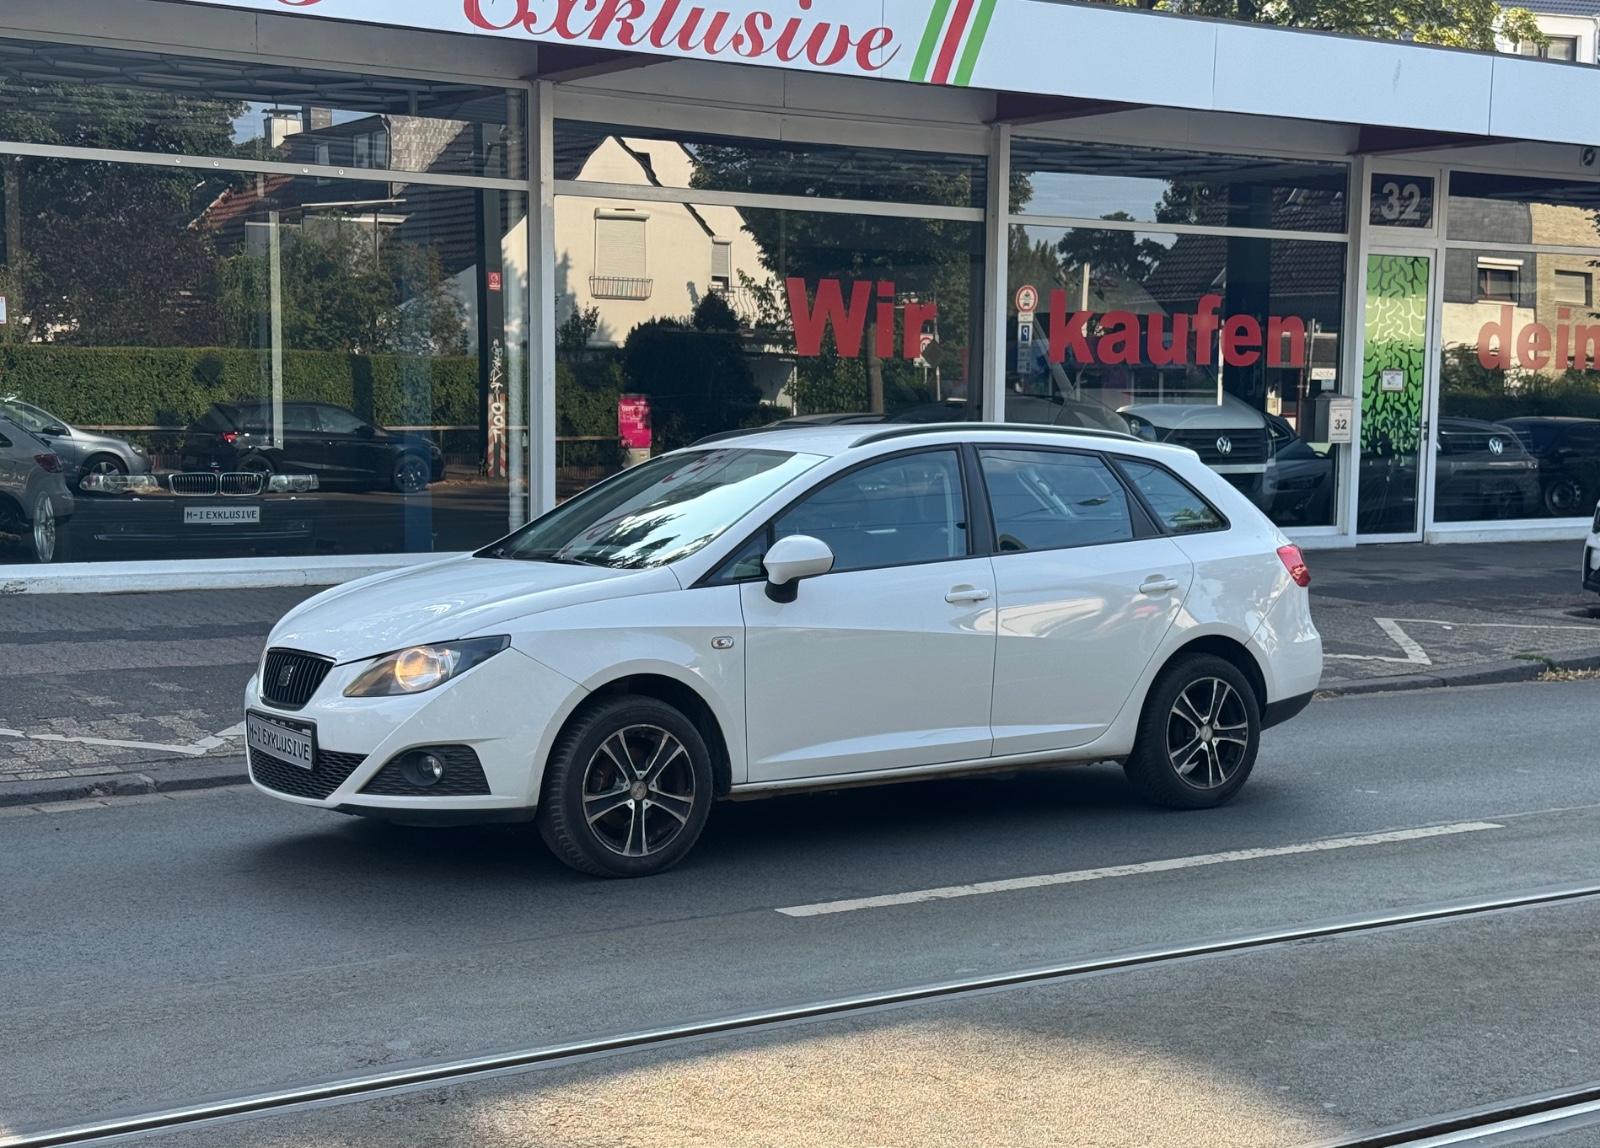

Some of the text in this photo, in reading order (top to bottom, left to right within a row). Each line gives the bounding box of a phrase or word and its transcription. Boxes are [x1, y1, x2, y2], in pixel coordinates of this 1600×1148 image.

[1381, 182, 1421, 220] 32
[785, 277, 938, 360] Wir
[1049, 288, 1306, 369] kaufen
[1334, 419, 1347, 430] 32
[205, 510, 257, 520] EXKLUSIVE
[262, 727, 310, 762] EXKLUSIVE
